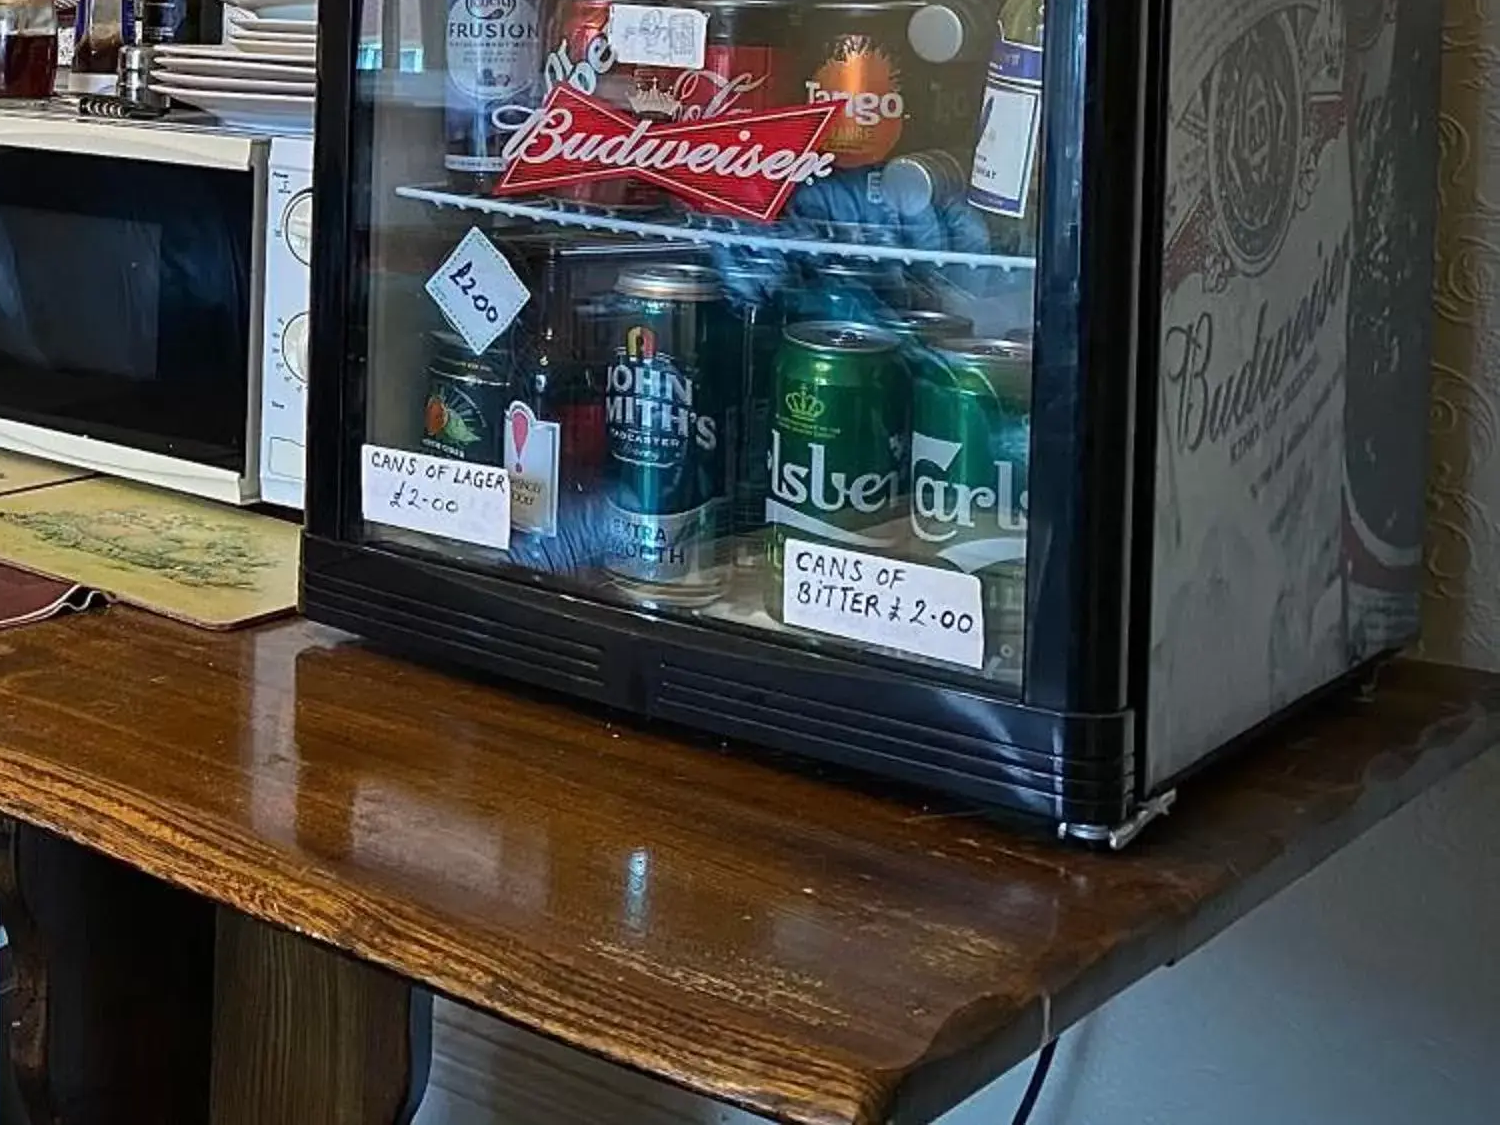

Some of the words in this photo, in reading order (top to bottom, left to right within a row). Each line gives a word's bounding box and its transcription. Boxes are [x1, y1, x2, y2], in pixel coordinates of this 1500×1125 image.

[450, 22, 539, 38] FRUSION
[491, 103, 834, 181] Budweiser
[606, 361, 693, 406] JOHN
[371, 451, 418, 475] CANS
[425, 464, 447, 481] OF
[453, 467, 506, 493] LAGER
[612, 518, 667, 543] EXTRA
[795, 551, 863, 583] CANS
[876, 567, 906, 586] OF
